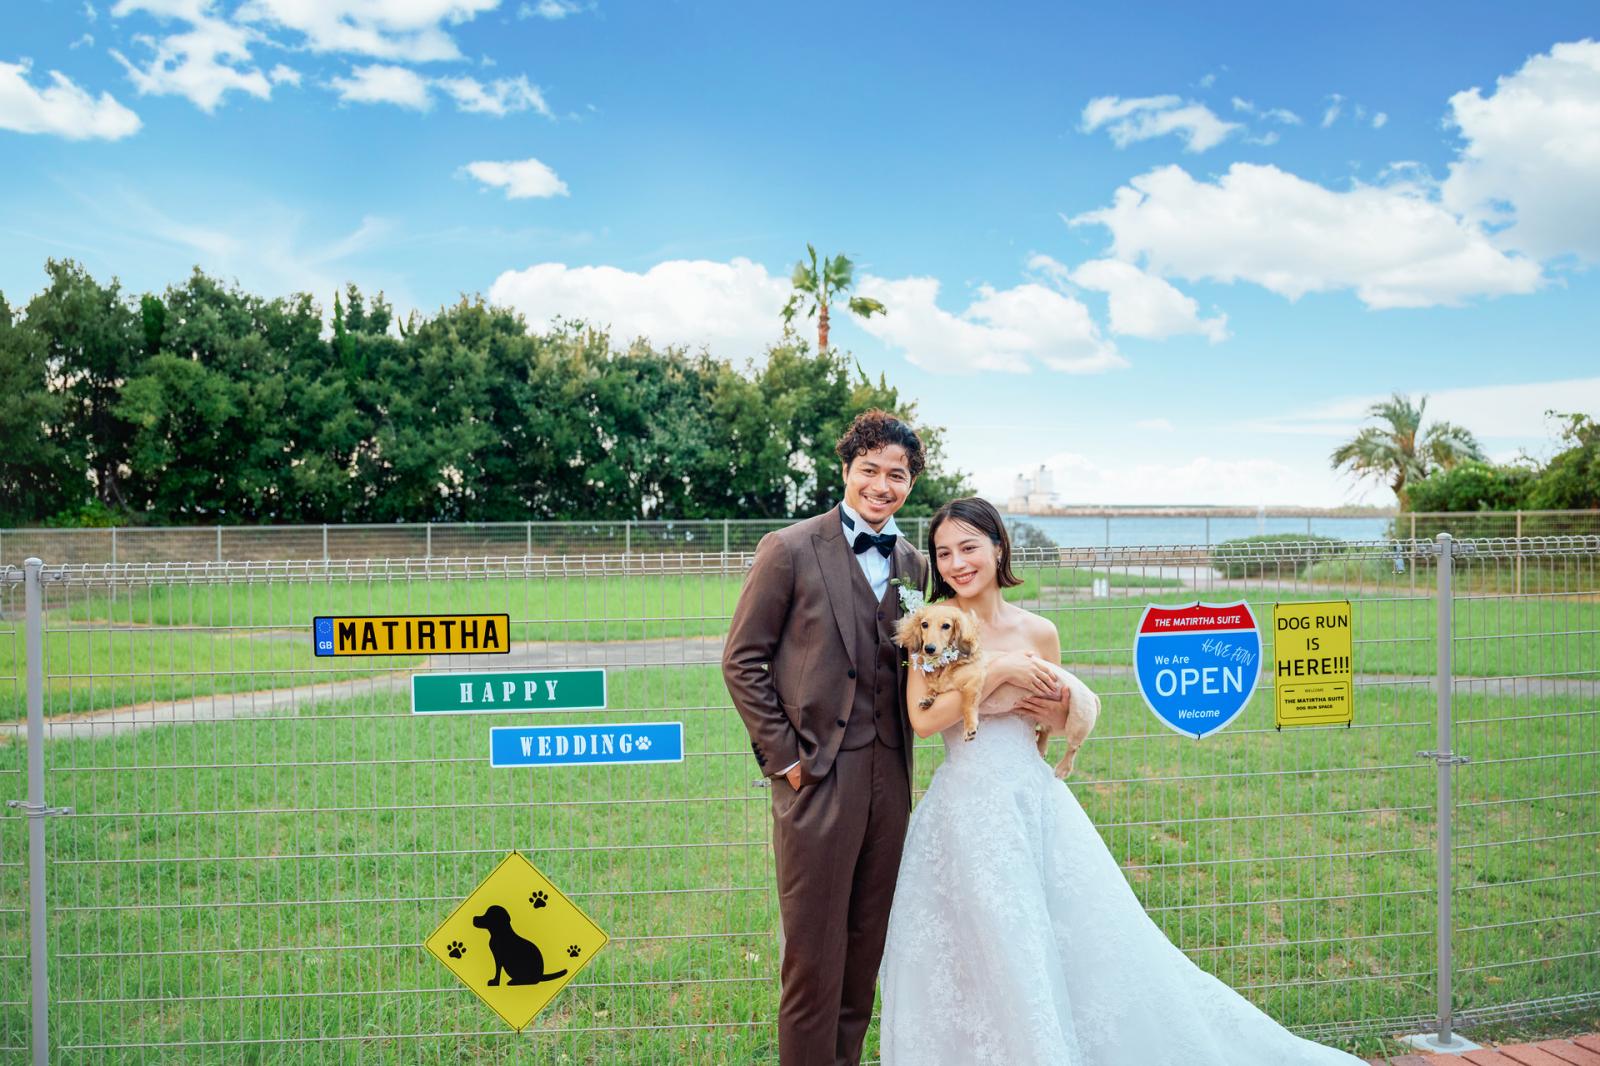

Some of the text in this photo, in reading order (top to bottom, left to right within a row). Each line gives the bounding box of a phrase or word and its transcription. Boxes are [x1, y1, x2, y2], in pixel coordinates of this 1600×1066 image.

[1155, 615, 1241, 627] THE MATIRTHA SUITE
[1277, 615, 1348, 631] DOG RUN
[319, 619, 499, 651] GB MATIRTHA
[1306, 637, 1320, 651] IS
[1201, 638, 1233, 658] HAVE
[1154, 654, 1190, 665] We Are
[1278, 656, 1349, 677] HERE!!!
[1155, 665, 1243, 697] OPEN
[460, 680, 558, 704] HAPPY
[1178, 708, 1220, 719] Welcome
[520, 733, 633, 758] WEDDING
